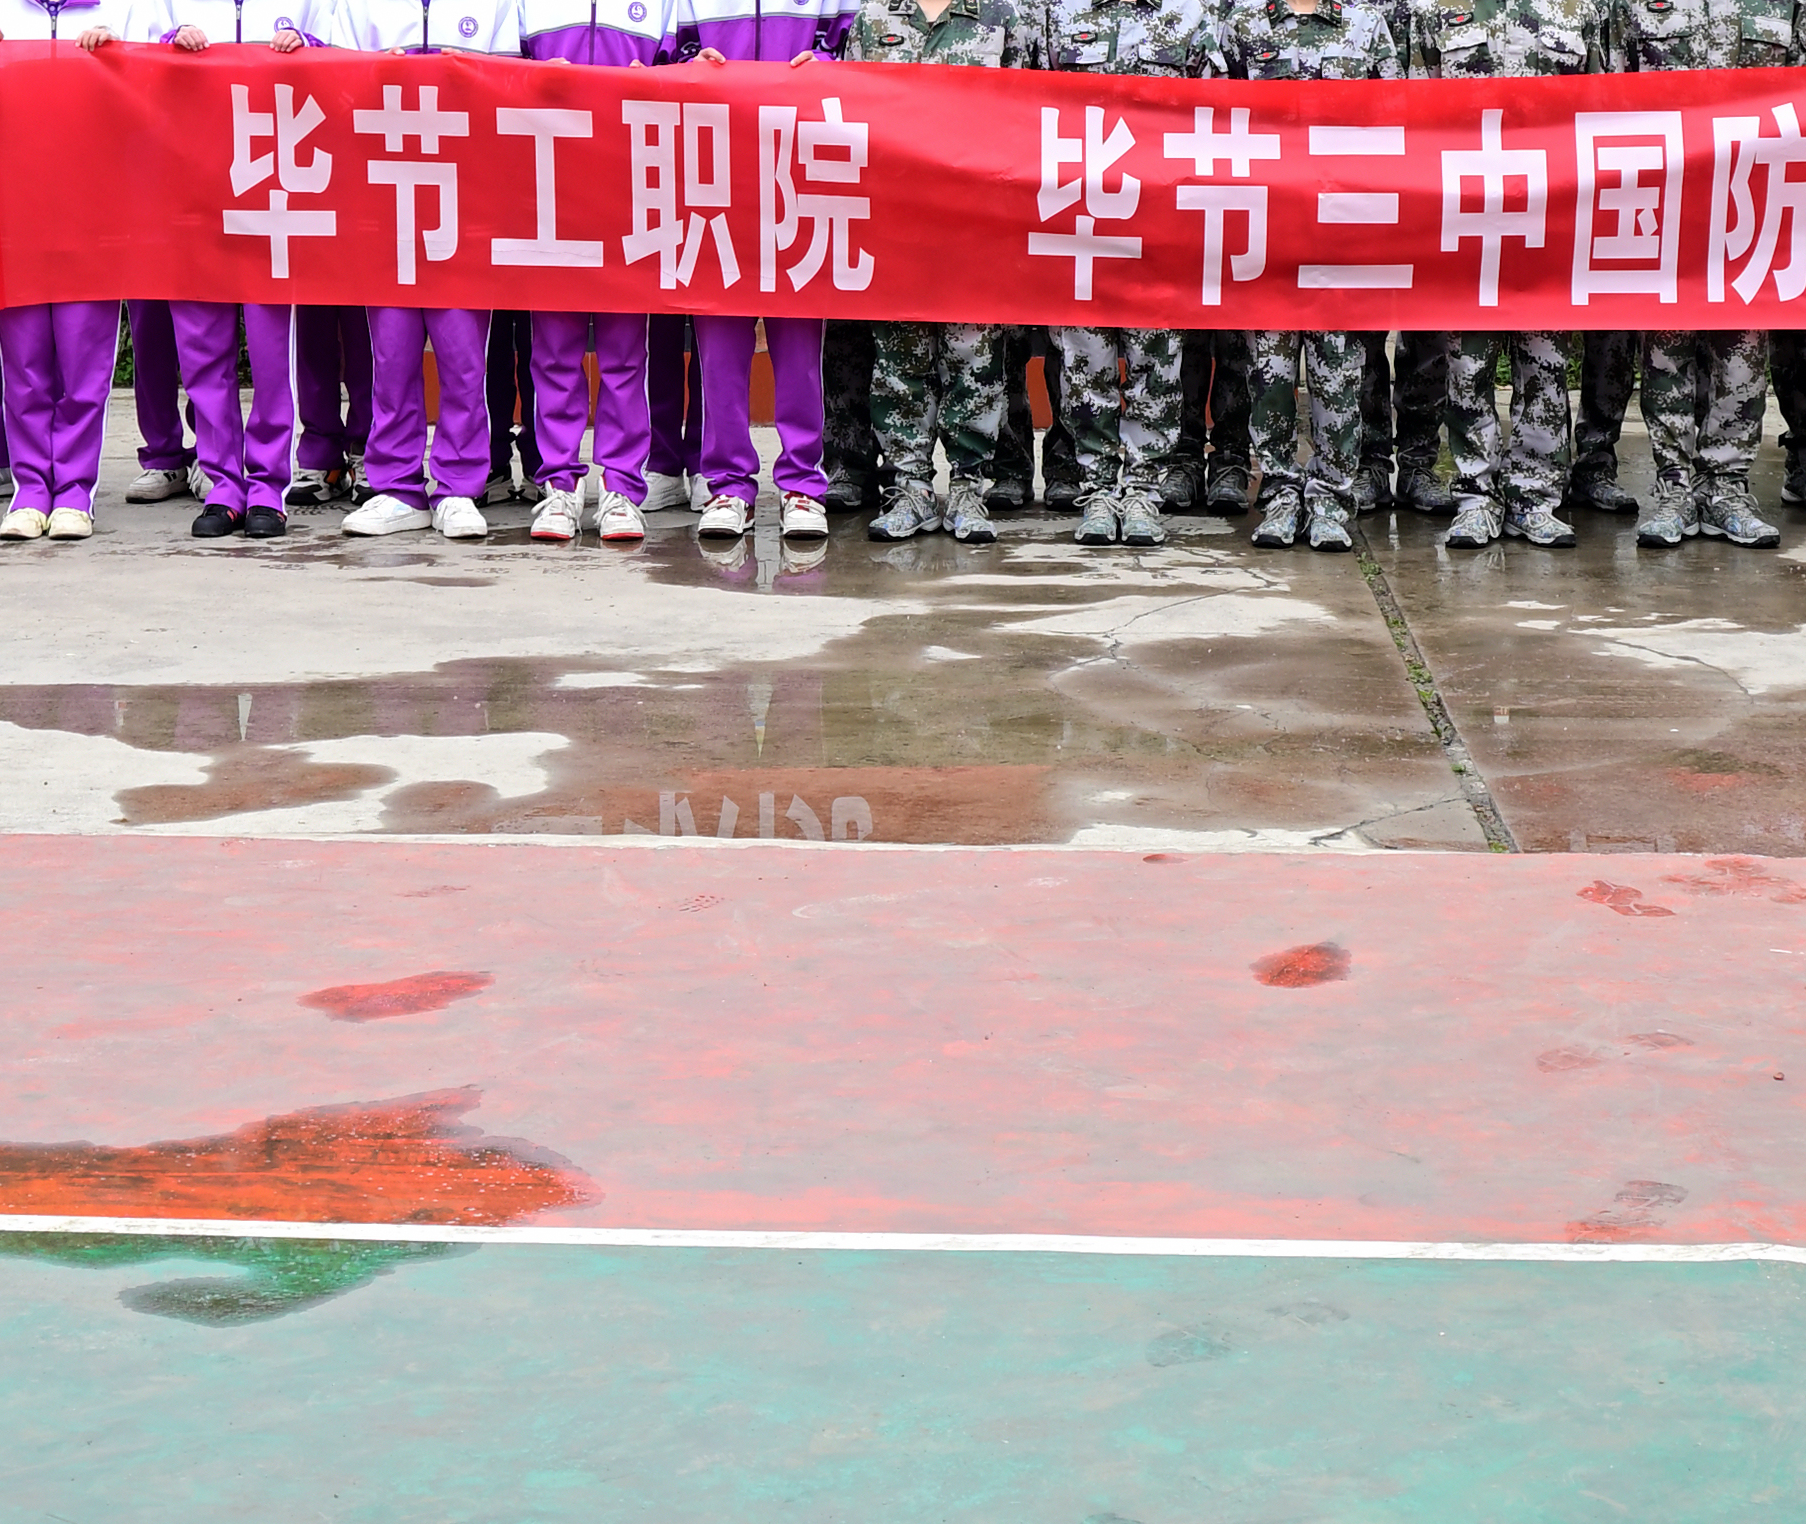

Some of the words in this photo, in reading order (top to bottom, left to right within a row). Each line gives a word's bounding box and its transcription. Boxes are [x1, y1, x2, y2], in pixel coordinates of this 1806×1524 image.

[222, 83, 876, 294] 毕节工职院
